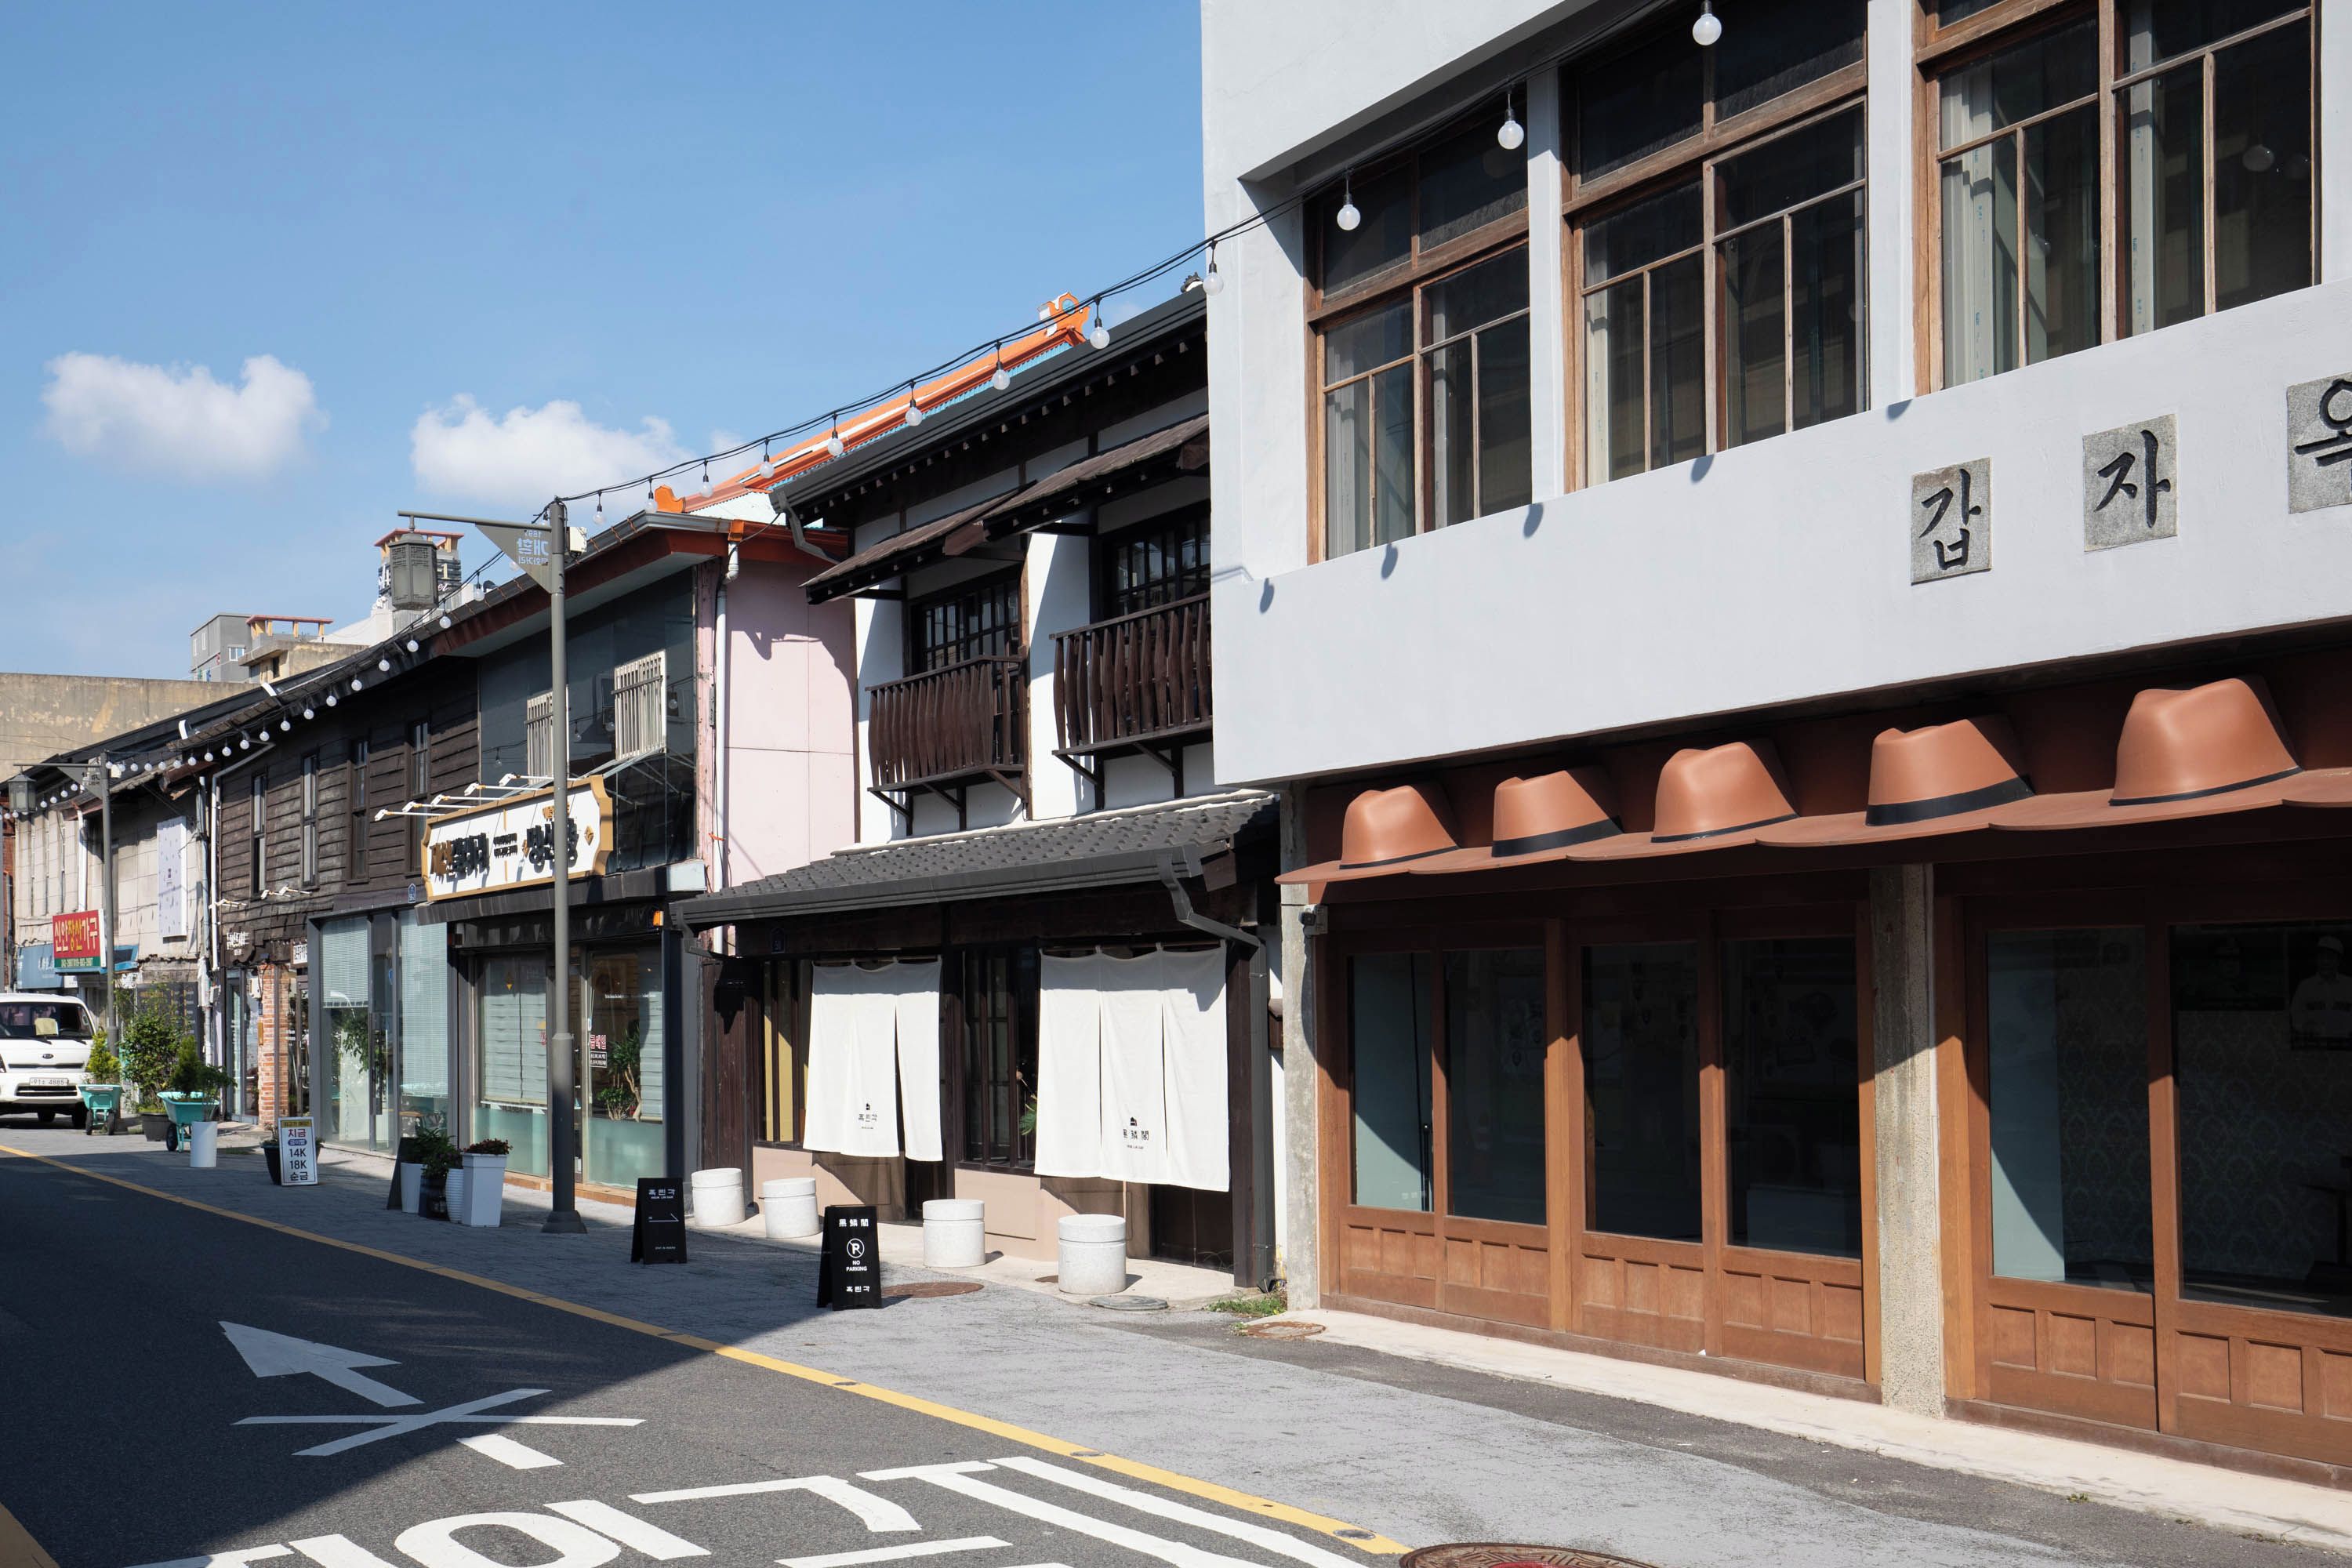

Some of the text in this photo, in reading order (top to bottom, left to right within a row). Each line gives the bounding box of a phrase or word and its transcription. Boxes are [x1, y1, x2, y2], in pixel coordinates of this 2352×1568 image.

[55, 917, 98, 953] 신안장산가구
[289, 1148, 307, 1158] 14K
[289, 1160, 307, 1170] 18K
[289, 1171, 308, 1181] 순금
